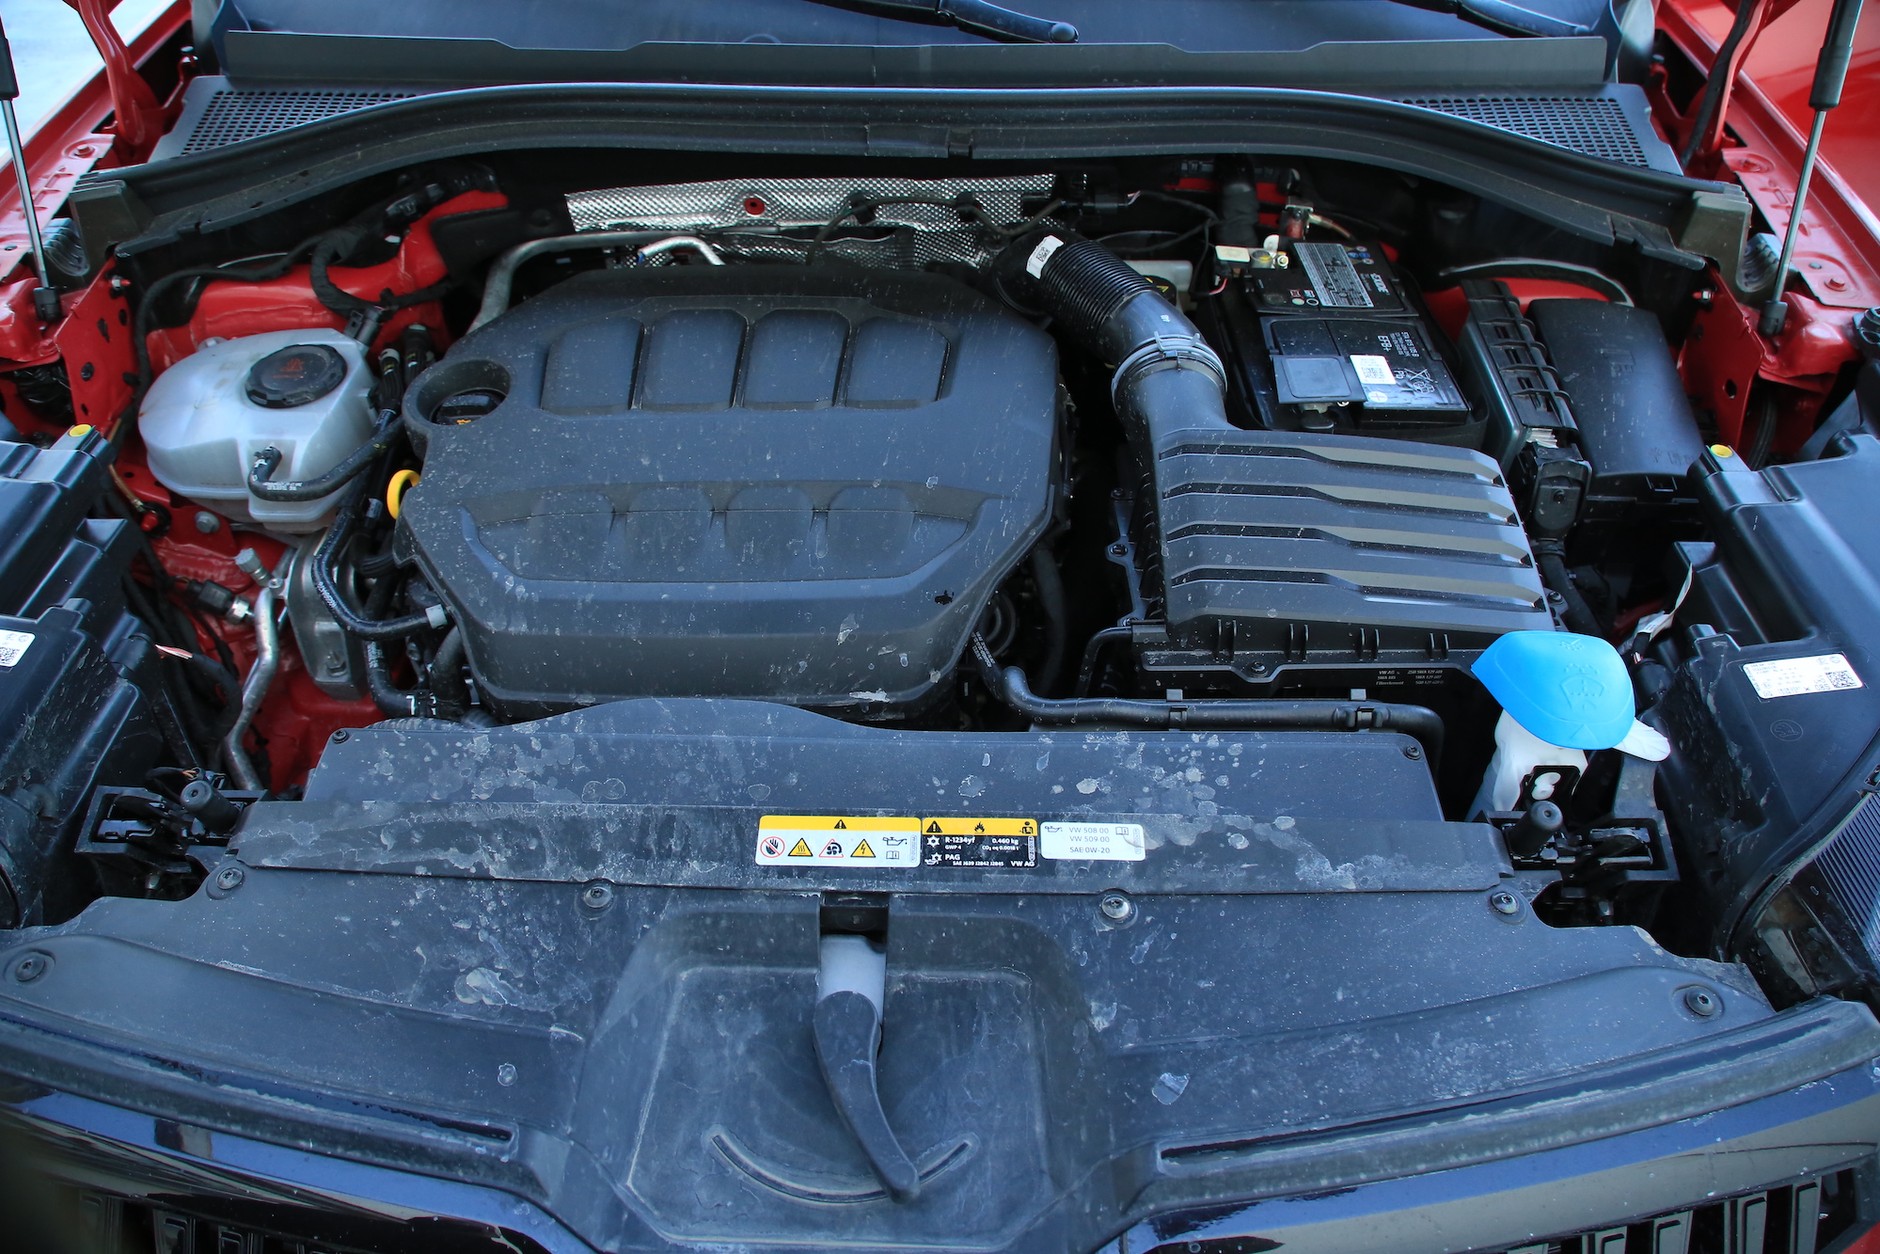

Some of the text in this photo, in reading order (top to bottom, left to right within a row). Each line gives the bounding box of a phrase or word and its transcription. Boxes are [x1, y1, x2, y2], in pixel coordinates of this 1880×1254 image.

[1378, 335, 1392, 352] EFB+
[945, 836, 975, 845] R-1234yf
[1010, 837, 1019, 845] kg
